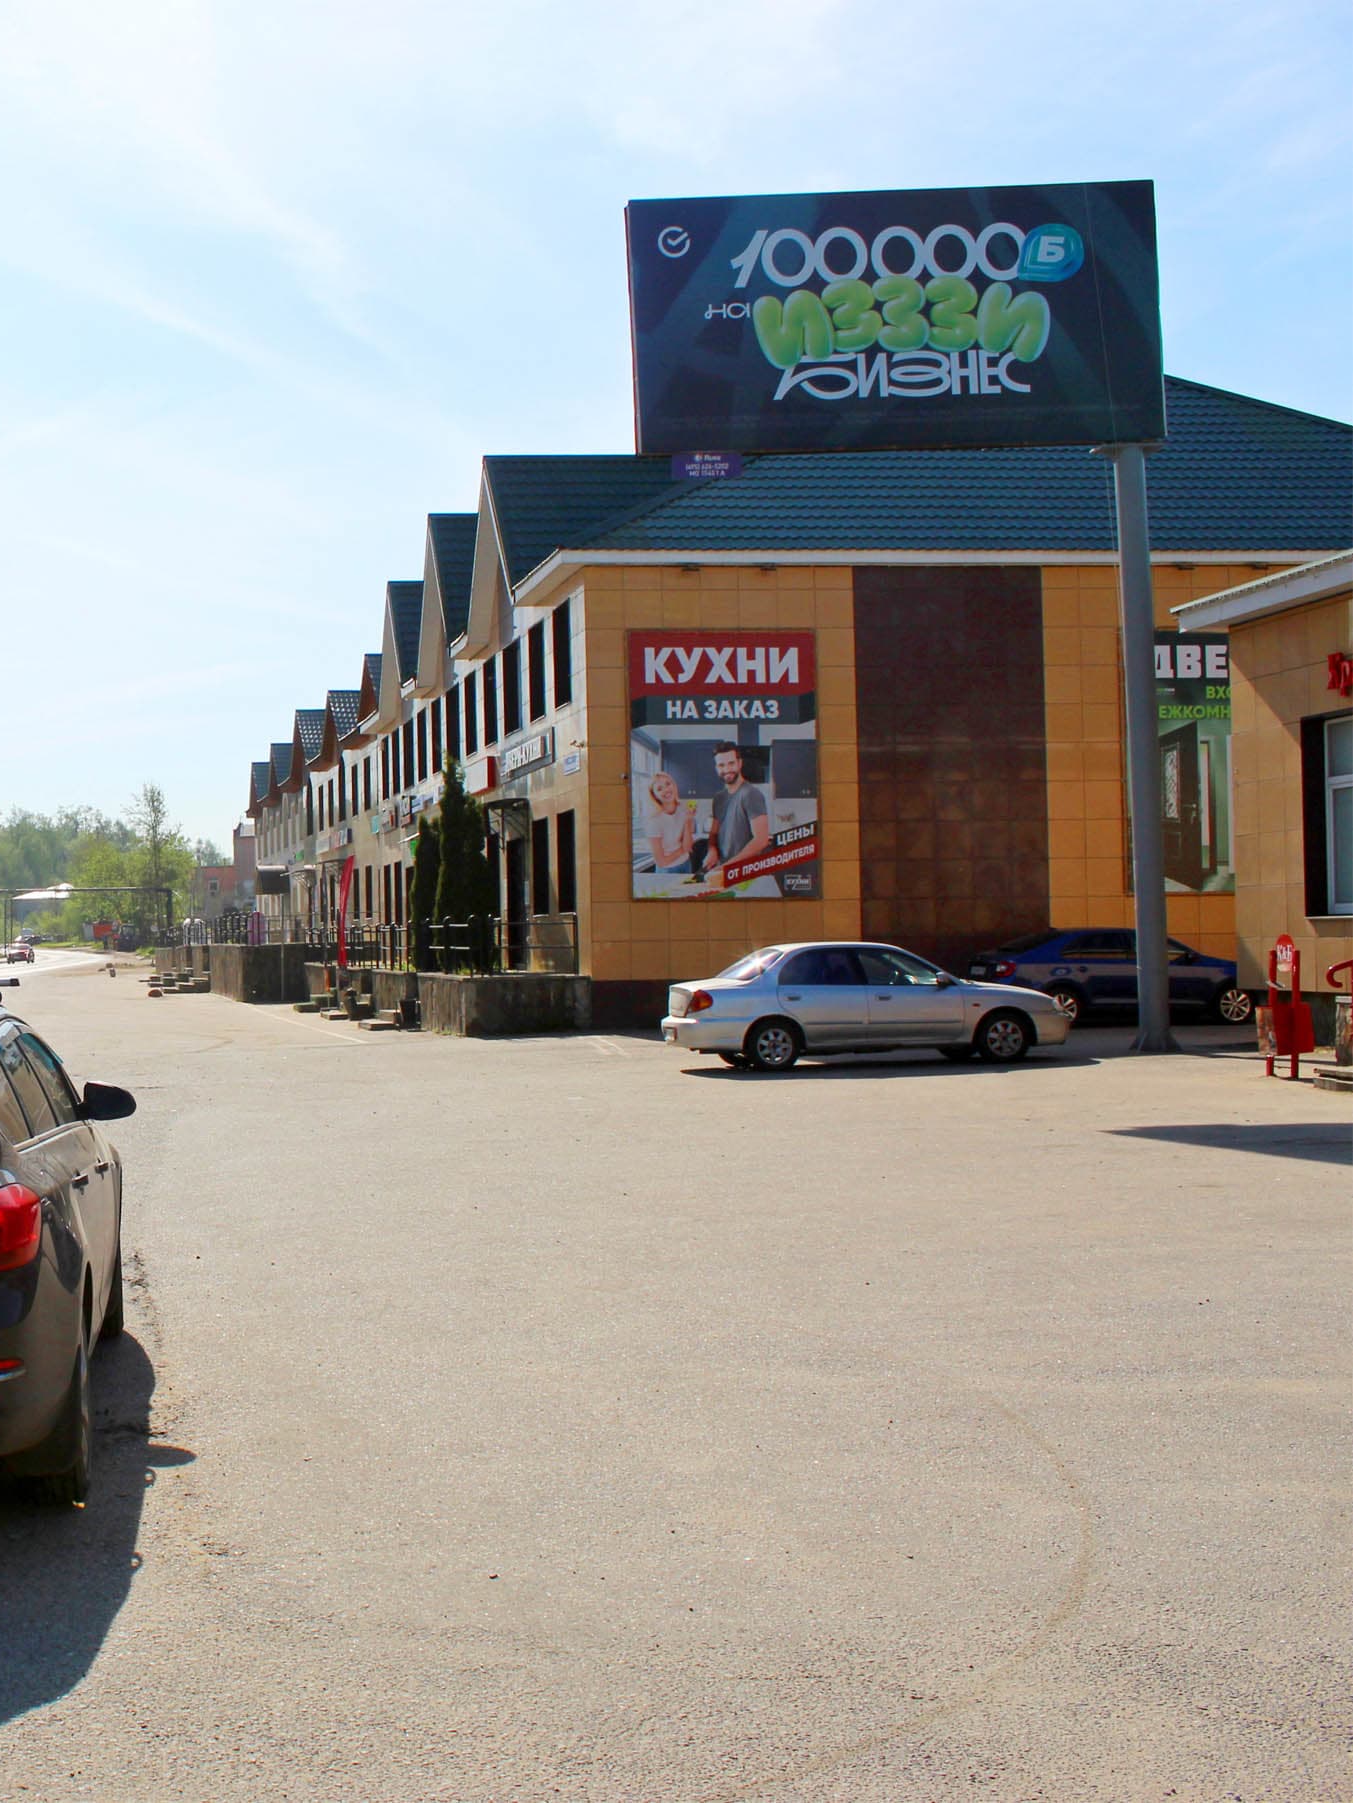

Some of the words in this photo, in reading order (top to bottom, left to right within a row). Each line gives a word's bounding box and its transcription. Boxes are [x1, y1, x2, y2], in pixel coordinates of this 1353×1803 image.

[773, 349, 1031, 400] БИЗНЕС
[644, 647, 799, 684] КУХНИ
[666, 700, 699, 719] НА
[704, 700, 779, 719] ЗАКАЗ
[776, 823, 815, 846] ЦЕНЫ
[727, 868, 740, 880] ОТ
[742, 844, 815, 876] ПРОИЗВОДИТЕЛЯ
